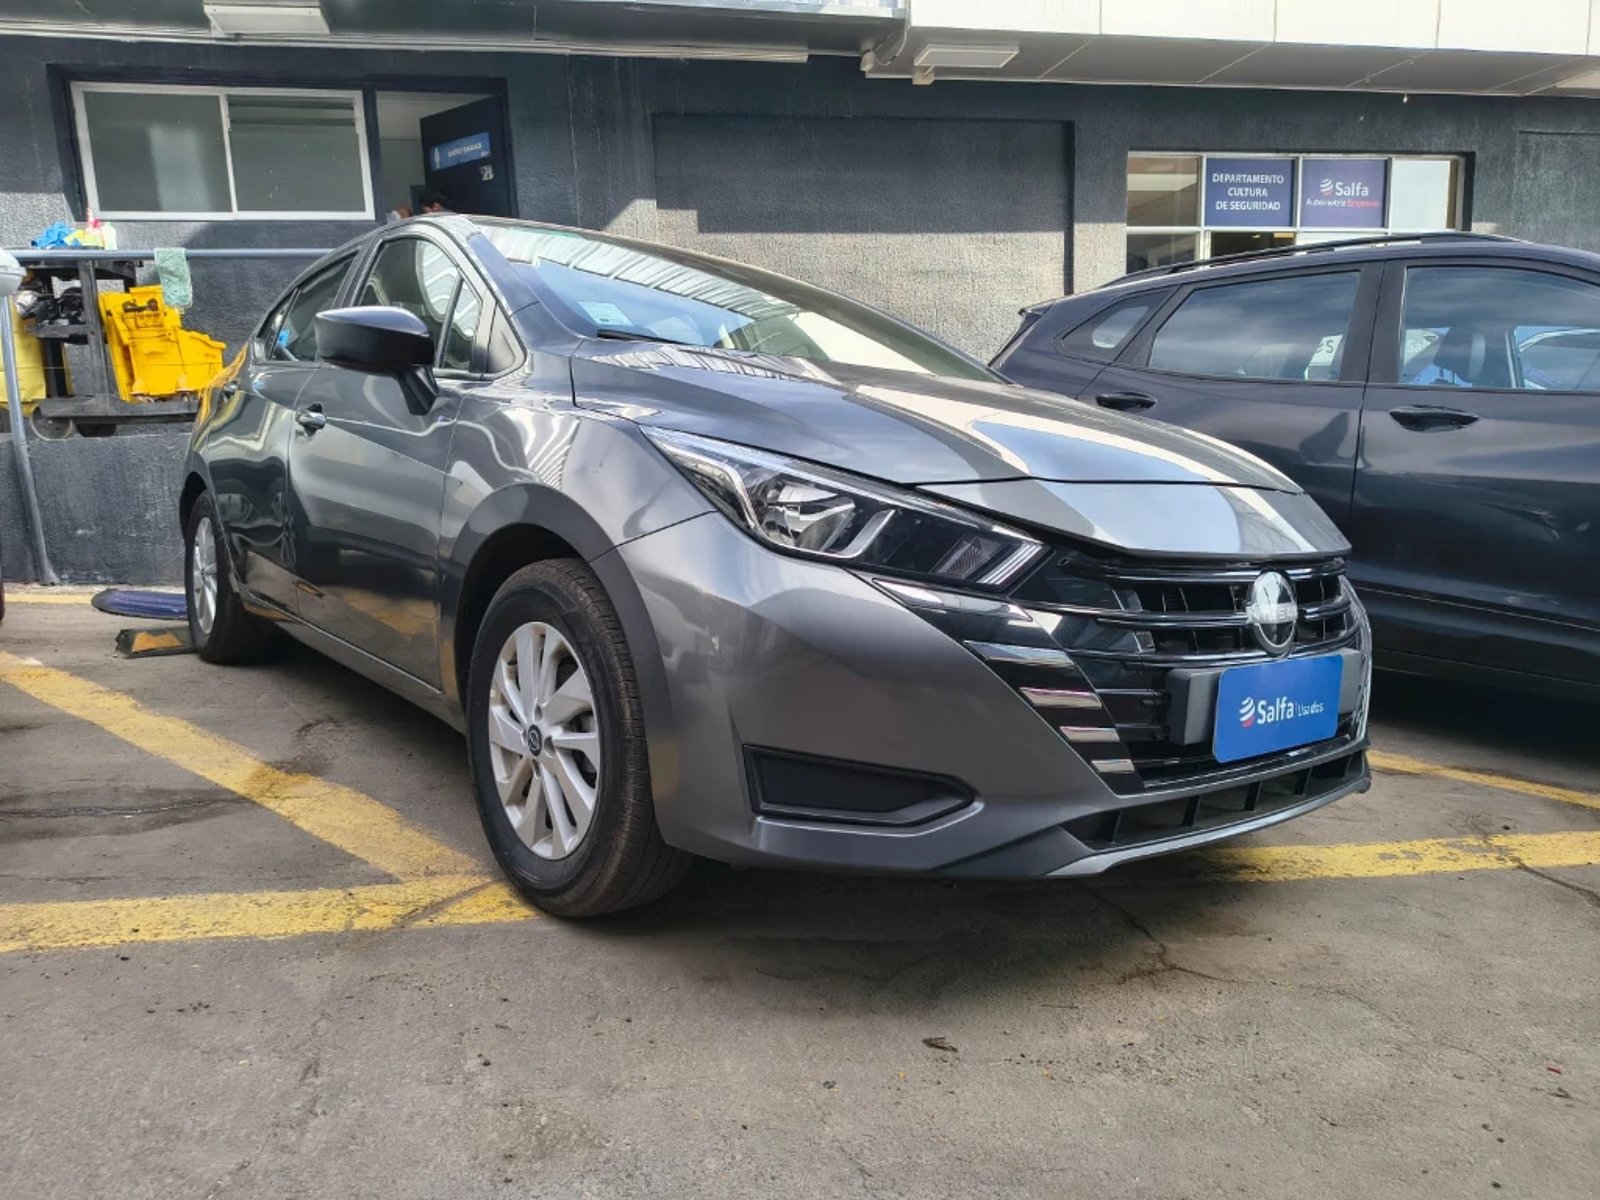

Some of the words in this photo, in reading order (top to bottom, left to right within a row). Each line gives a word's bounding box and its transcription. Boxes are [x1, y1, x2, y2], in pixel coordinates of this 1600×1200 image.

[1212, 173, 1284, 184] DEPARTAMENTO
[1227, 187, 1268, 197] CULTURA
[1335, 182, 1369, 197] Salfa
[1215, 201, 1229, 211] DE
[1229, 201, 1281, 211] SEGURIDAD
[1257, 696, 1295, 725] Salfa
[1297, 700, 1325, 717] Usados
